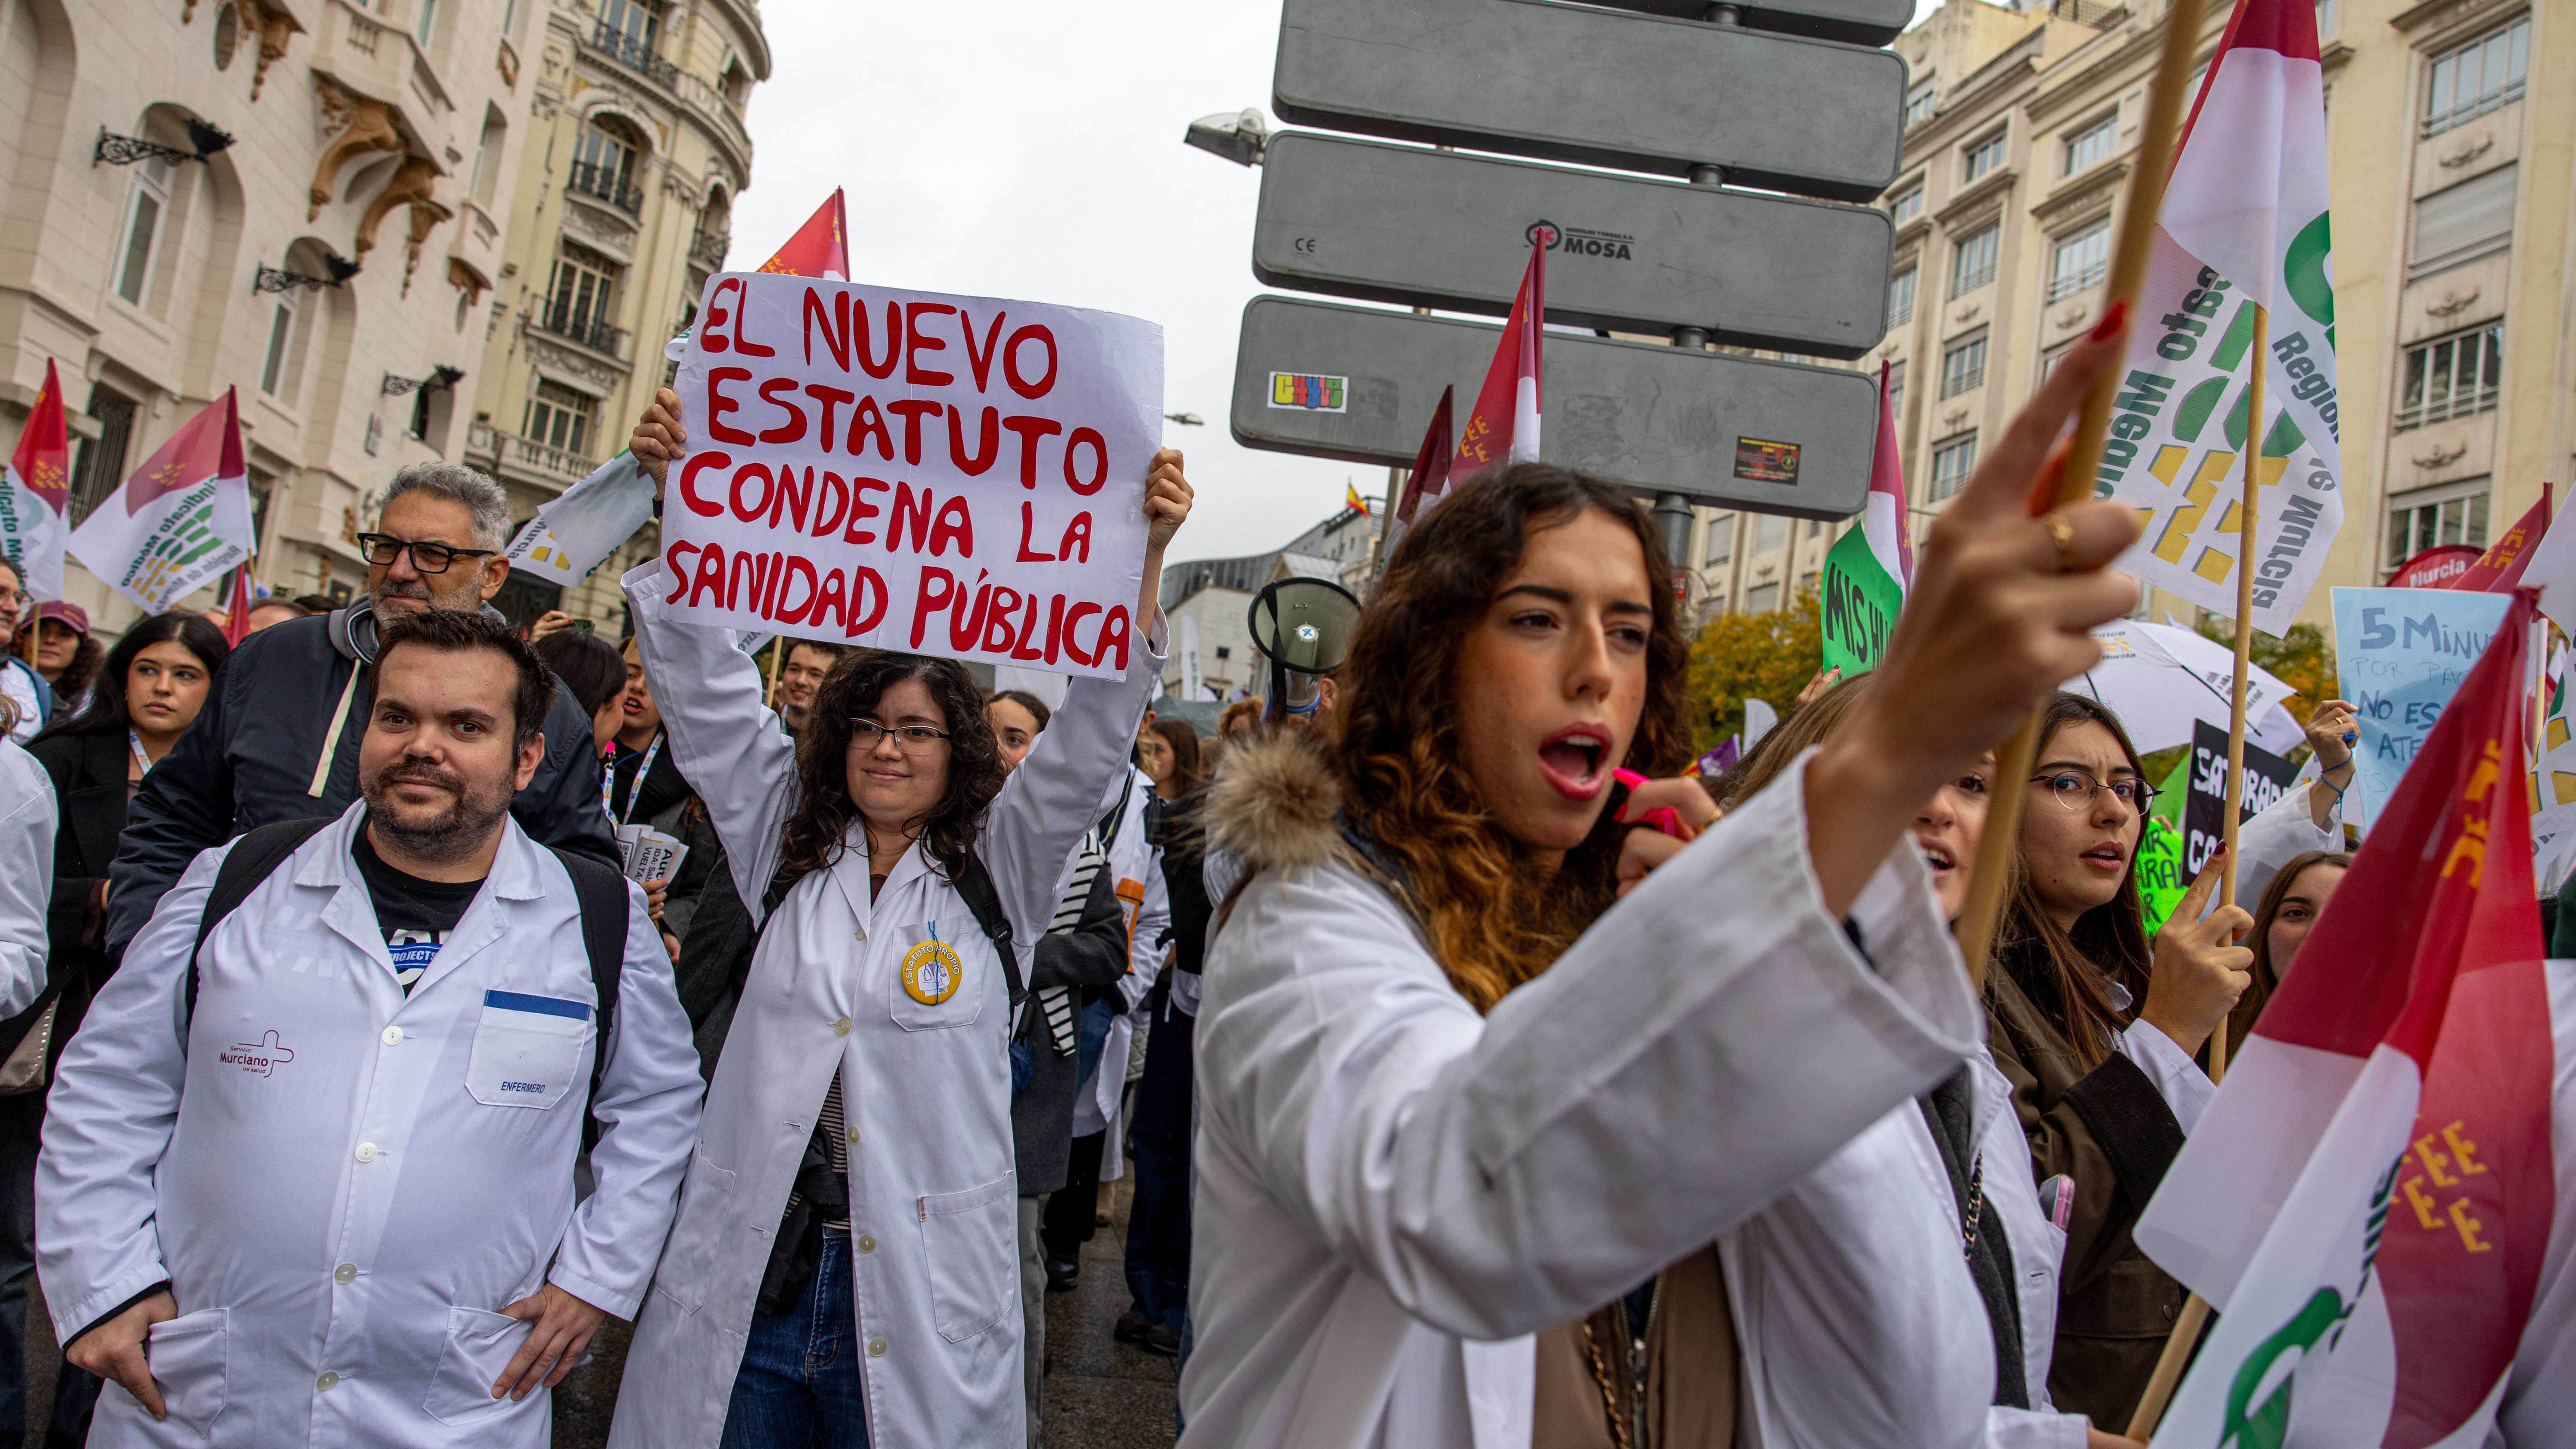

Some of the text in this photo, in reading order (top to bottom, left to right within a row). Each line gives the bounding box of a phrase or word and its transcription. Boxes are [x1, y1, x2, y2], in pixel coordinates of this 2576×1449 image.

[1564, 237, 1631, 261] MOSA
[701, 278, 1057, 400] EL NUEVO
[708, 367, 1108, 496] ESTATUTO
[680, 451, 1092, 563] CONDENA LA
[2409, 558, 2466, 588] Murcia
[666, 540, 1130, 671] SANIDAD PÚBLICA
[1825, 562, 1867, 664] MIS
[2360, 607, 2396, 650] 5
[2350, 657, 2403, 678] POR
[2356, 690, 2393, 719] NO
[635, 847, 652, 881] VUELTA:
[651, 848, 662, 867] IDA:
[656, 848, 673, 880] Aut
[905, 945, 960, 985] ESTATUTO PROPIO
[220, 1052, 268, 1066] Murciano
[501, 1081, 545, 1093] ENFERMERO
